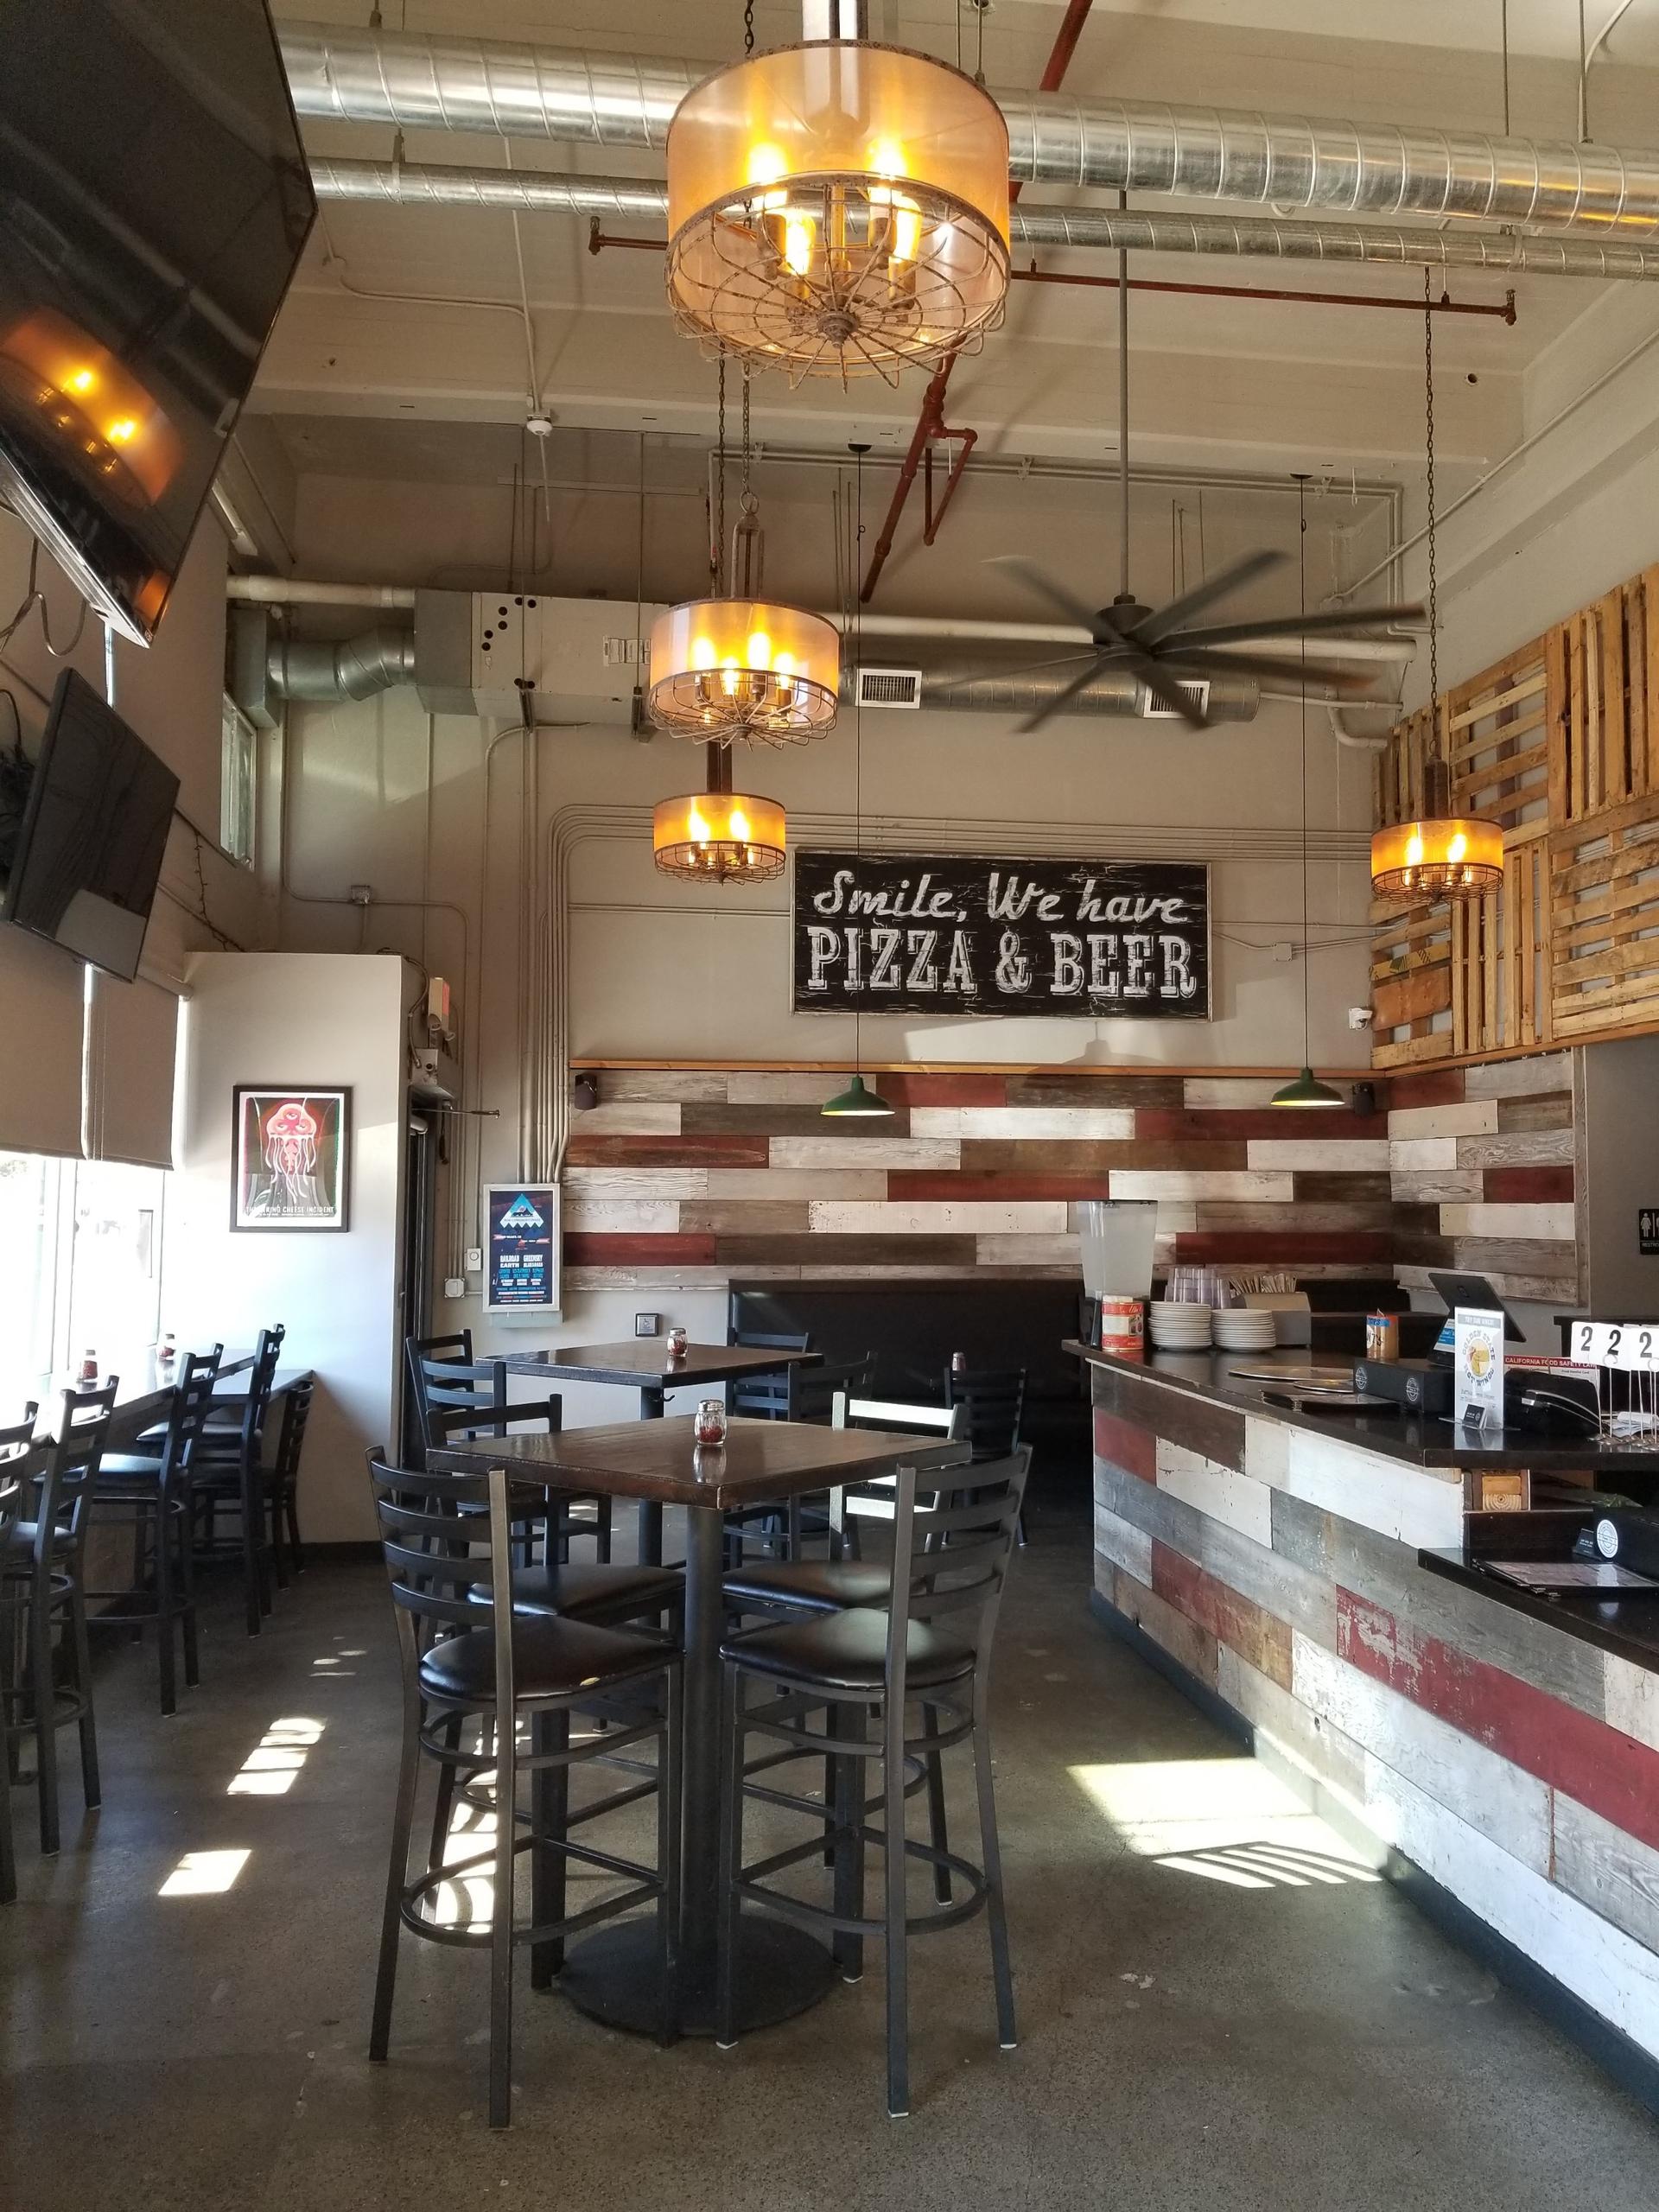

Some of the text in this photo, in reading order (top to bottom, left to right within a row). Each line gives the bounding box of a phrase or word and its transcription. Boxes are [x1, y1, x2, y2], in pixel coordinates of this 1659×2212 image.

[814, 870, 1188, 924] Smile, We have
[807, 927, 1197, 998] PIZZA & BEER
[1580, 1325, 1593, 1351] 2
[1607, 1329, 1622, 1356] 2
[1639, 1332, 1652, 1358] 2
[1505, 1357, 1541, 1365] CALIFORNIA
